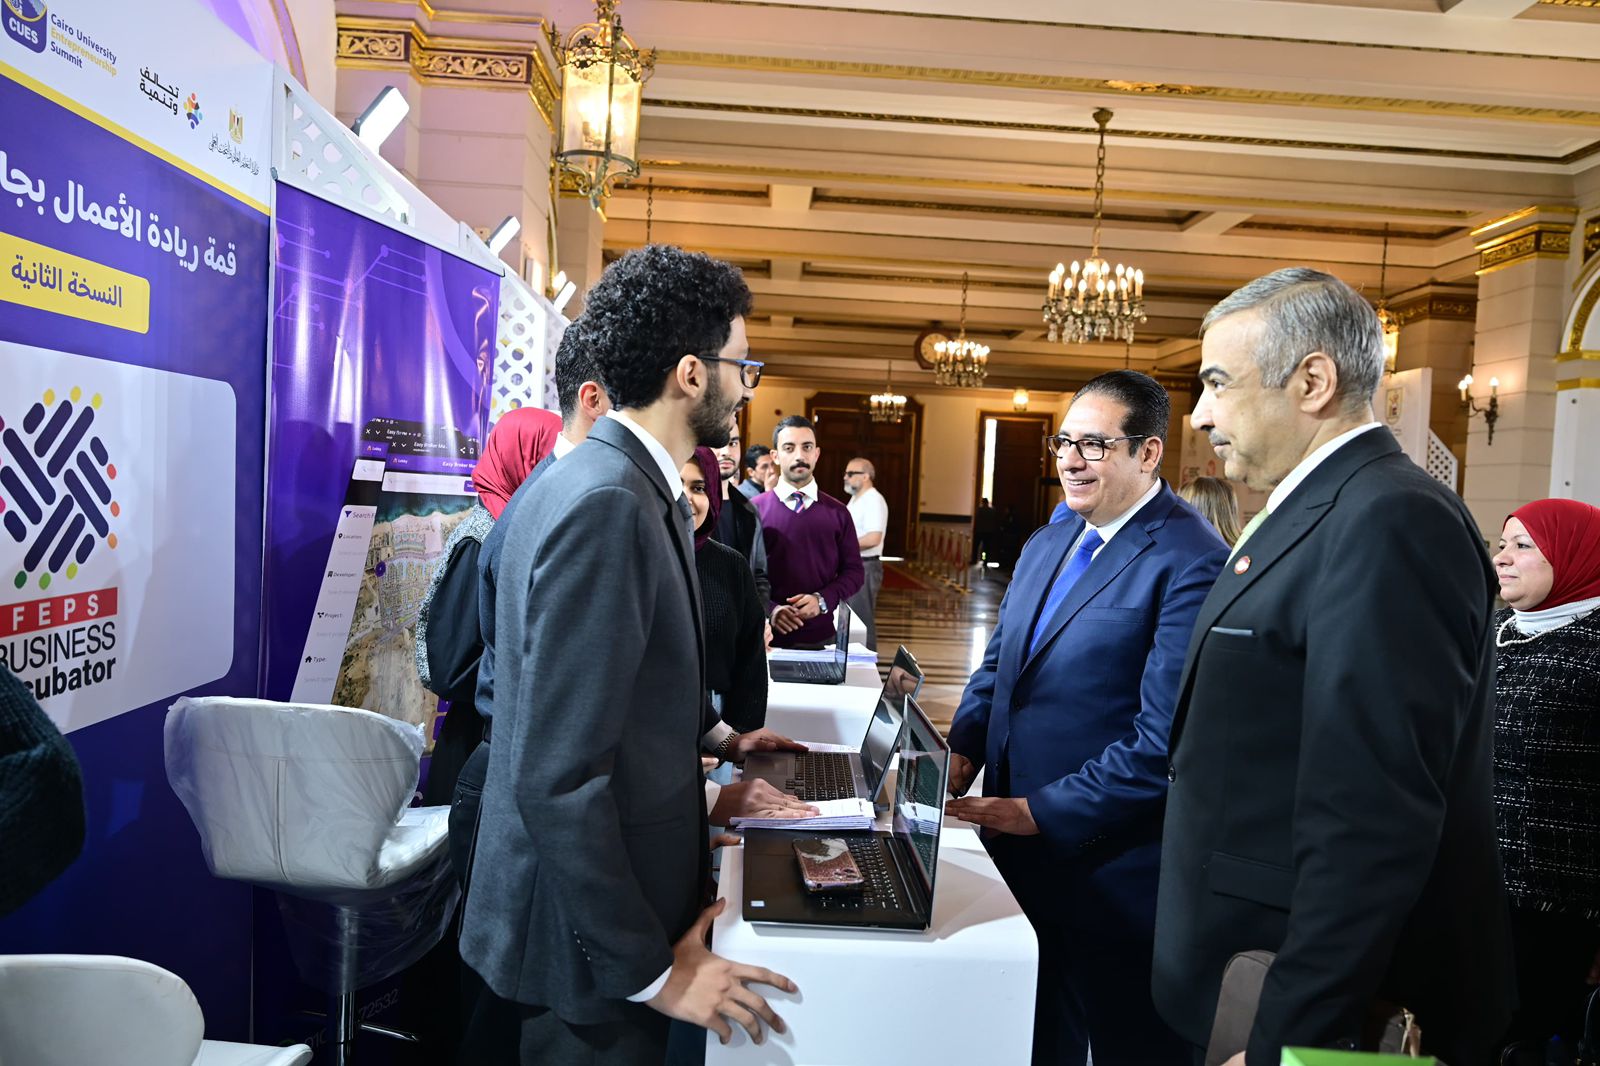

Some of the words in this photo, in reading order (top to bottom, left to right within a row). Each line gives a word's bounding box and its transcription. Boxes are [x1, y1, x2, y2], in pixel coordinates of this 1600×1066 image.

[8, 17, 39, 44] CUES
[50, 13, 74, 36] Cairo
[76, 29, 117, 65] University
[50, 41, 83, 68] Summit
[139, 78, 178, 116] وتنمية
[140, 66, 179, 98] تحالف
[53, 179, 142, 242] الأعمال
[147, 212, 199, 273] ريادة
[203, 236, 237, 276] قمة
[11, 254, 63, 293] الثانية
[67, 271, 123, 308] النسخة
[352, 511, 371, 519] Search
[12, 594, 99, 632] FEPS
[0, 621, 116, 674] BUSINESS
